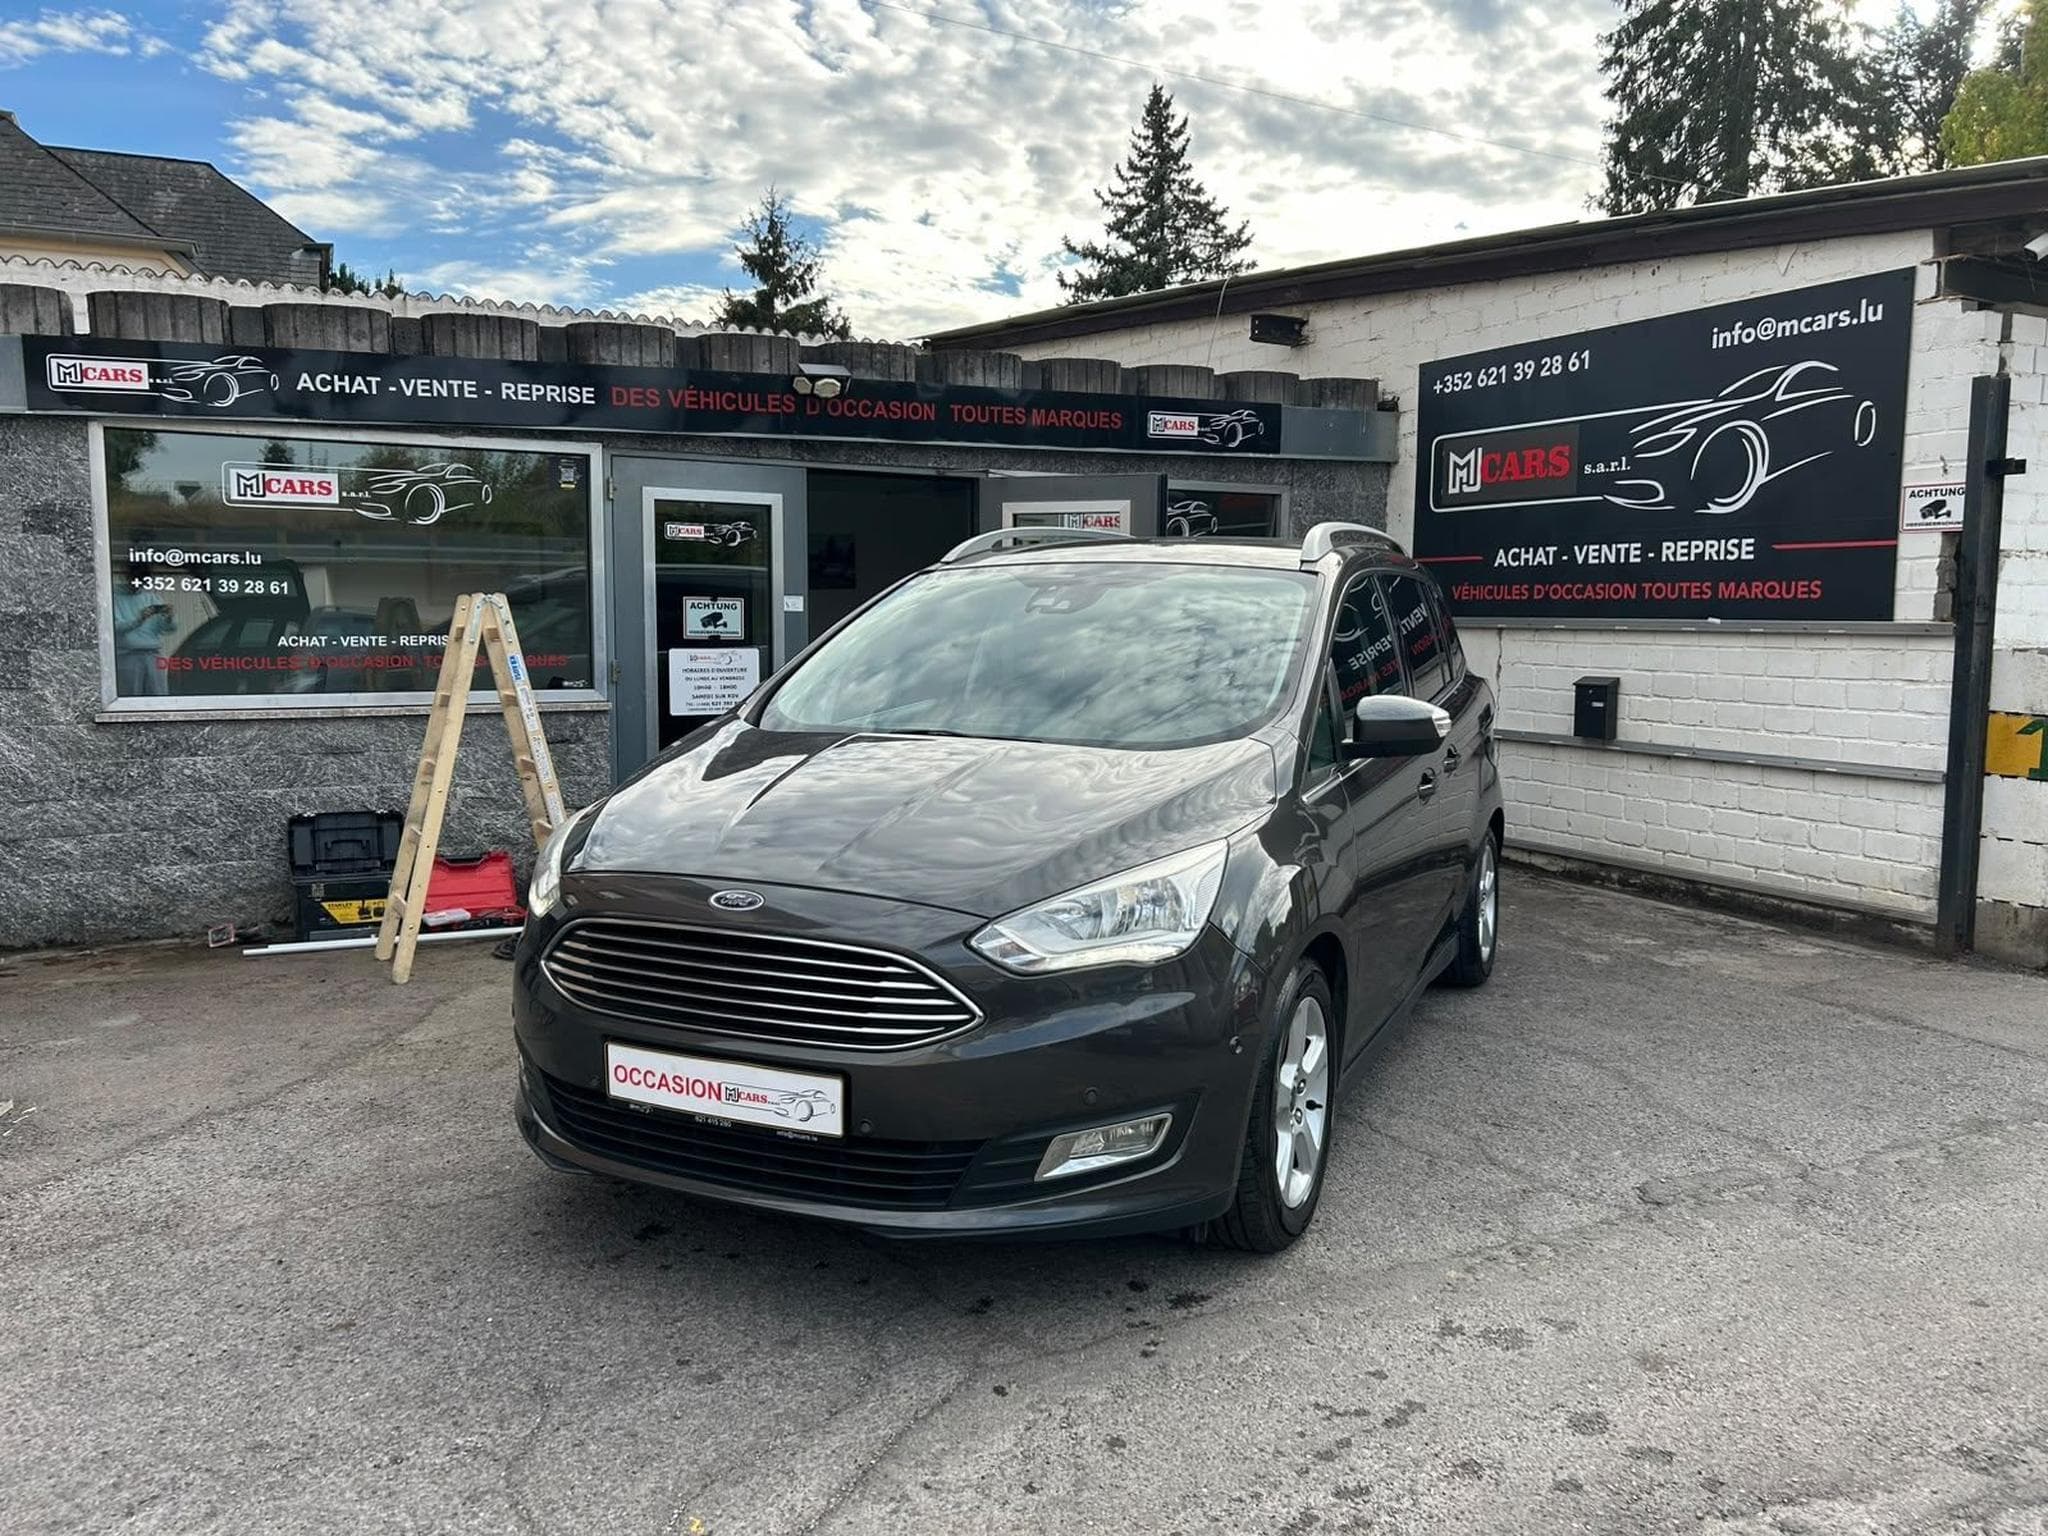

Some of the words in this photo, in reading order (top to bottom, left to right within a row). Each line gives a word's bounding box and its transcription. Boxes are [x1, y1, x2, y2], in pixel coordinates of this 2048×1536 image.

[1711, 298, 1884, 350] info@mcars.lu
[1433, 371, 1472, 394] +352
[1477, 365, 1507, 387] 621
[1513, 360, 1535, 382] 39
[1540, 355, 1562, 377] 28
[1568, 349, 1590, 372] 61
[296, 372, 381, 395] ACHAT
[399, 378, 478, 398] VENTE
[501, 382, 596, 404] REPRISE
[610, 385, 660, 408] DES
[667, 386, 796, 414] VÉHICULES
[950, 404, 1026, 425] TOUTES
[1031, 407, 1123, 430] MARQUES
[1909, 486, 1965, 499] ACHTUNG
[129, 548, 262, 566] info@mcars.lu
[1494, 546, 1557, 568] ACHAT
[1574, 543, 1642, 565] VENTE
[1661, 538, 1755, 562] REPRISE
[130, 577, 175, 591] +352
[181, 577, 211, 592] 621
[218, 579, 239, 593] 39
[244, 580, 265, 594] 28
[270, 581, 289, 595] 61
[1452, 581, 1529, 600] VÉHICULES
[1534, 582, 1637, 600] D'OCCASION
[1642, 582, 1712, 600] TOUTES
[1717, 579, 1822, 600] MARQUES
[690, 601, 738, 611] ACHTUNG
[278, 635, 328, 647] ACHAT
[340, 635, 387, 647] VENTE
[400, 635, 450, 647] REPRIS
[156, 656, 193, 670] DES
[199, 654, 302, 670] VÉHICULES
[614, 1064, 721, 1101] OCCASION
